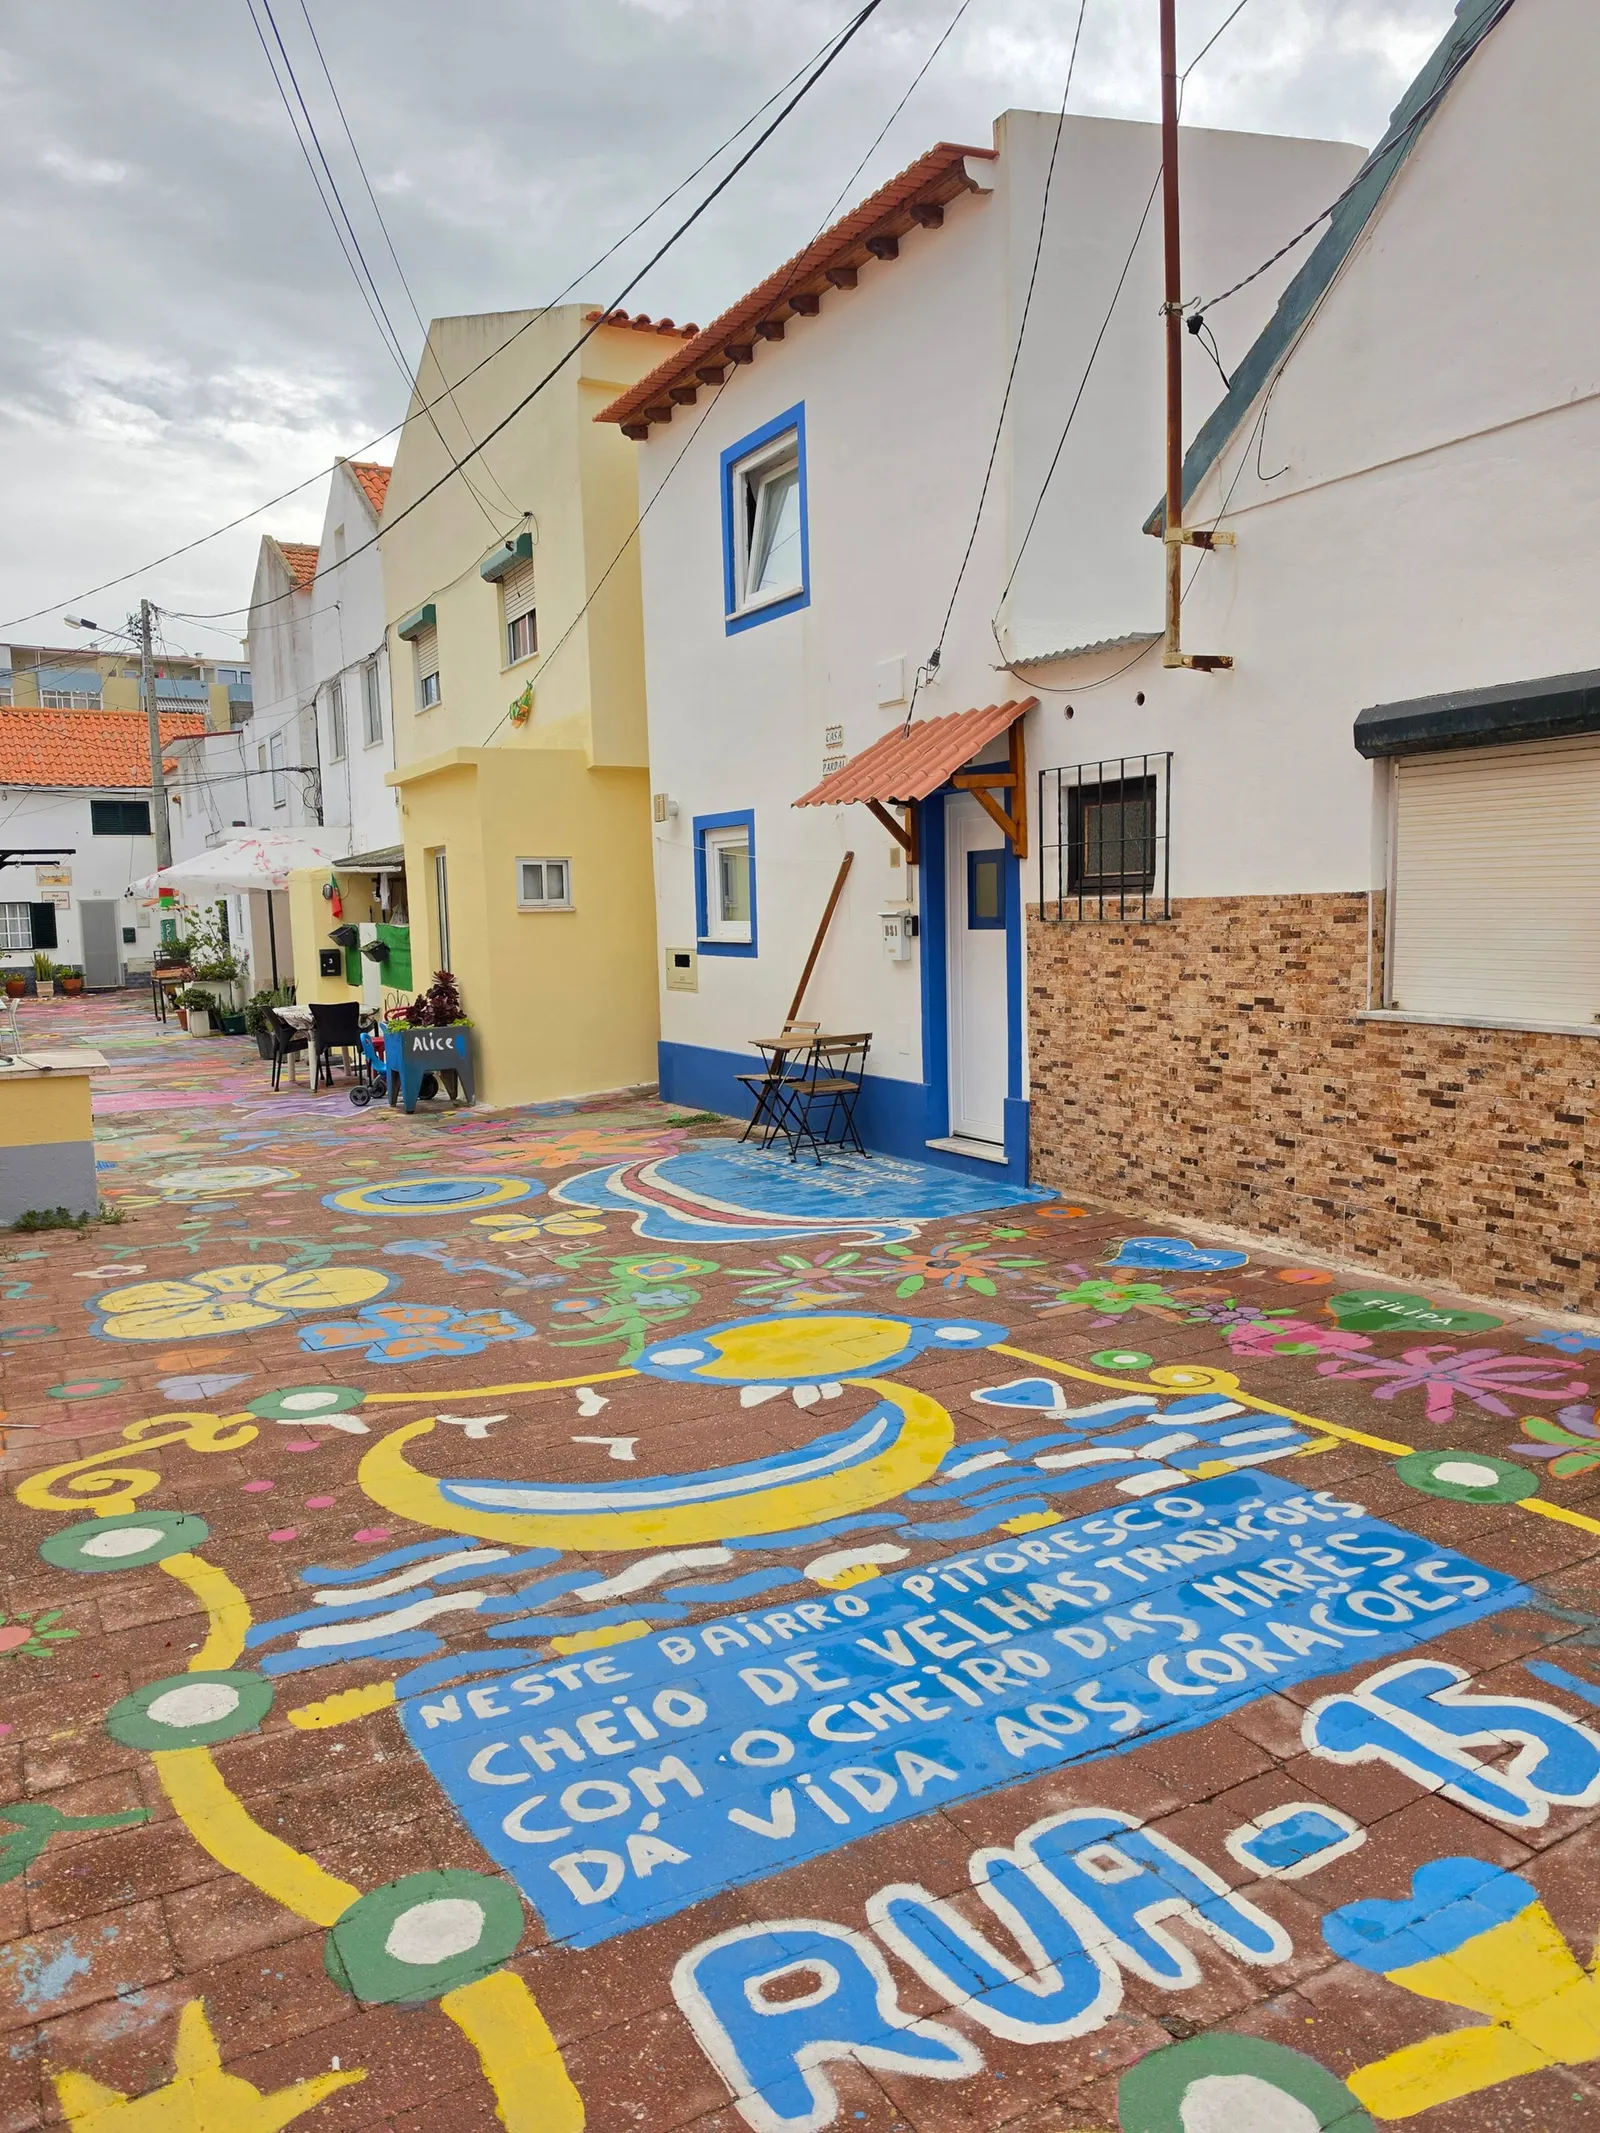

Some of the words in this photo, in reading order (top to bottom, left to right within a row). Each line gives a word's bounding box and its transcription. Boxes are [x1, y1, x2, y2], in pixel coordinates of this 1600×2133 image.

[825, 731, 842, 742] CASA
[412, 1032, 454, 1052] Alice
[419, 1655, 634, 1728] NESTE
[502, 1754, 704, 1843] COM
[729, 1729, 796, 1767] O
[1053, 1601, 1202, 1660] DAS
[1192, 1532, 1405, 1617] MARÉS
[738, 1650, 850, 1706] DE
[856, 1569, 1111, 1667] VELHAS
[548, 1812, 692, 1905] DÁ
[994, 1681, 1153, 1758] AOS
[671, 1807, 1293, 2133] RUA
